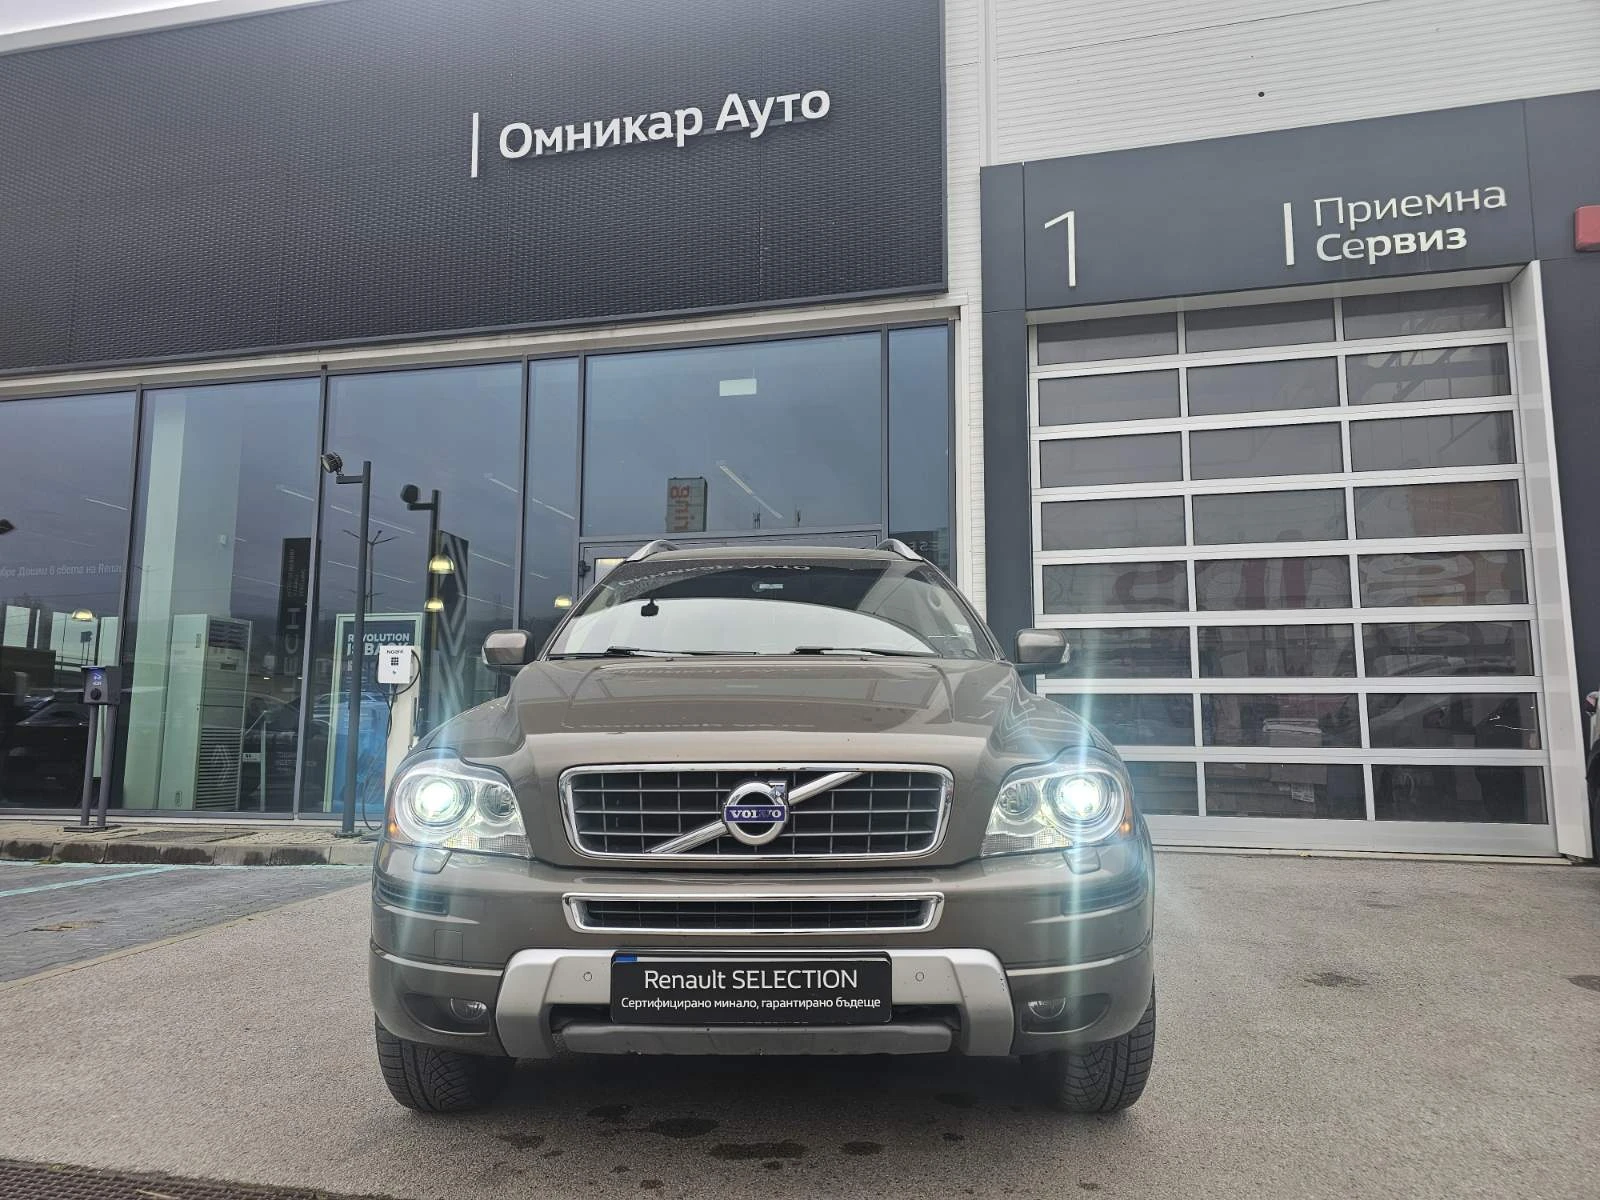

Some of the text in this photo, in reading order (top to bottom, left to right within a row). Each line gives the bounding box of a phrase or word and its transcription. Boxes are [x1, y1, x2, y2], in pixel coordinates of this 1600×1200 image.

[499, 90, 831, 159] Омникар Ауто
[1314, 186, 1508, 231] Приемна
[1044, 210, 1076, 287] 1
[1316, 227, 1468, 265] Сервиз
[729, 809, 782, 819] VOLVO
[644, 969, 858, 990] Renault SELECTION
[621, 996, 881, 1011] Сертифицирано минало, гарантирано бъдеще
